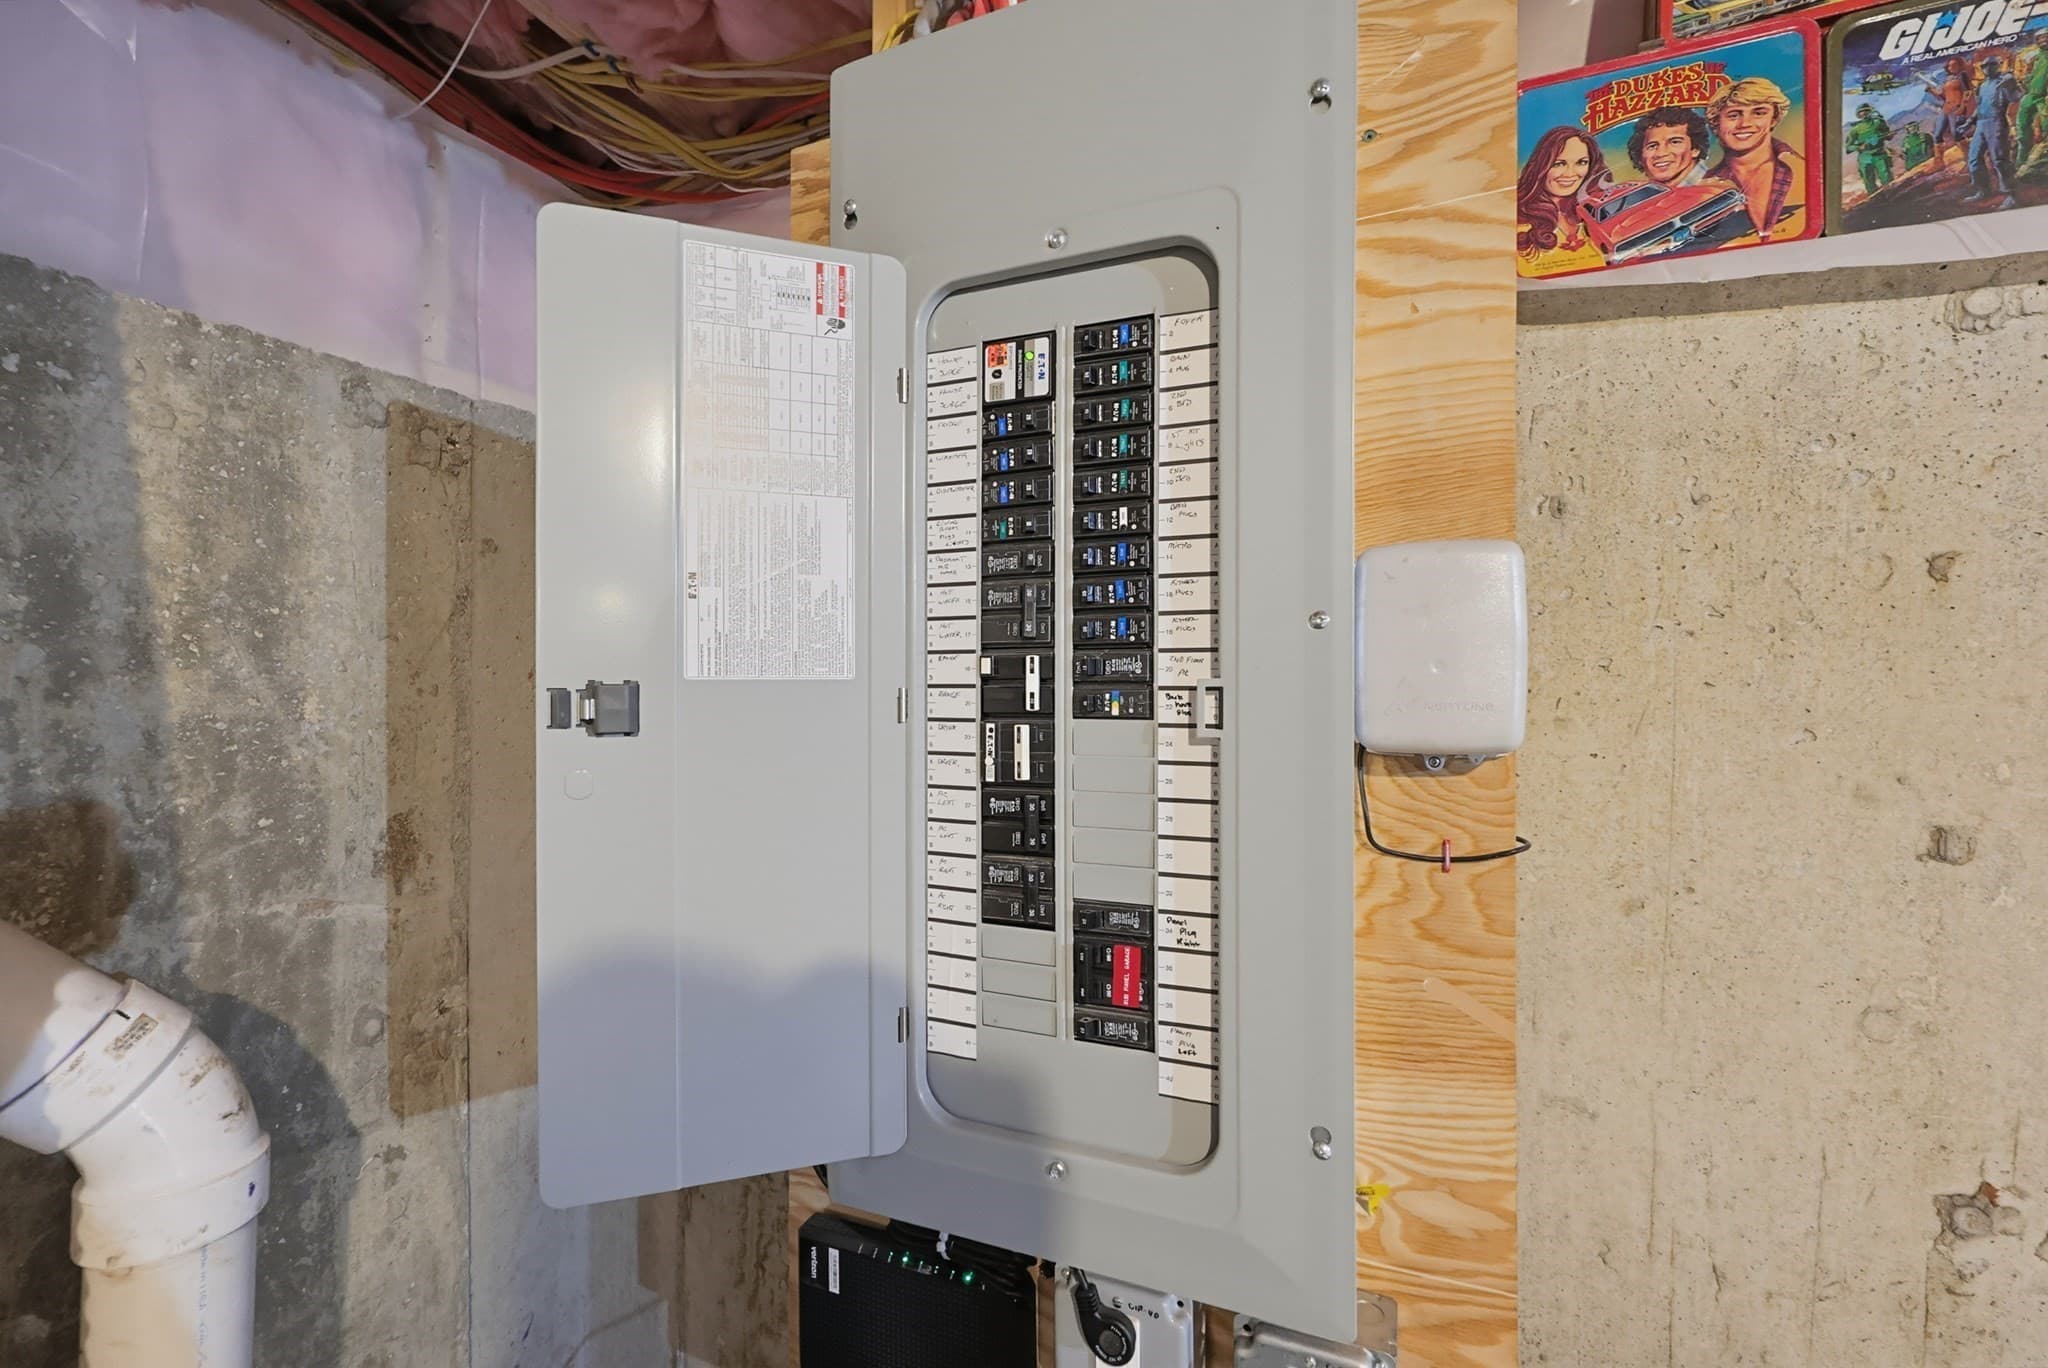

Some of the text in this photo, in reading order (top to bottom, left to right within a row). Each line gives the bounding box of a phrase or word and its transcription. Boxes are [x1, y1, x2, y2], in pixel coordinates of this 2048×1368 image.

[1929, 0, 2036, 50] JOE
[1910, 52, 1936, 63] REAL
[1935, 41, 1987, 59] AMERICAN
[1987, 35, 2017, 47] HERO
[1614, 61, 1704, 97] DUKES
[1581, 74, 1732, 136] HAZZARD
